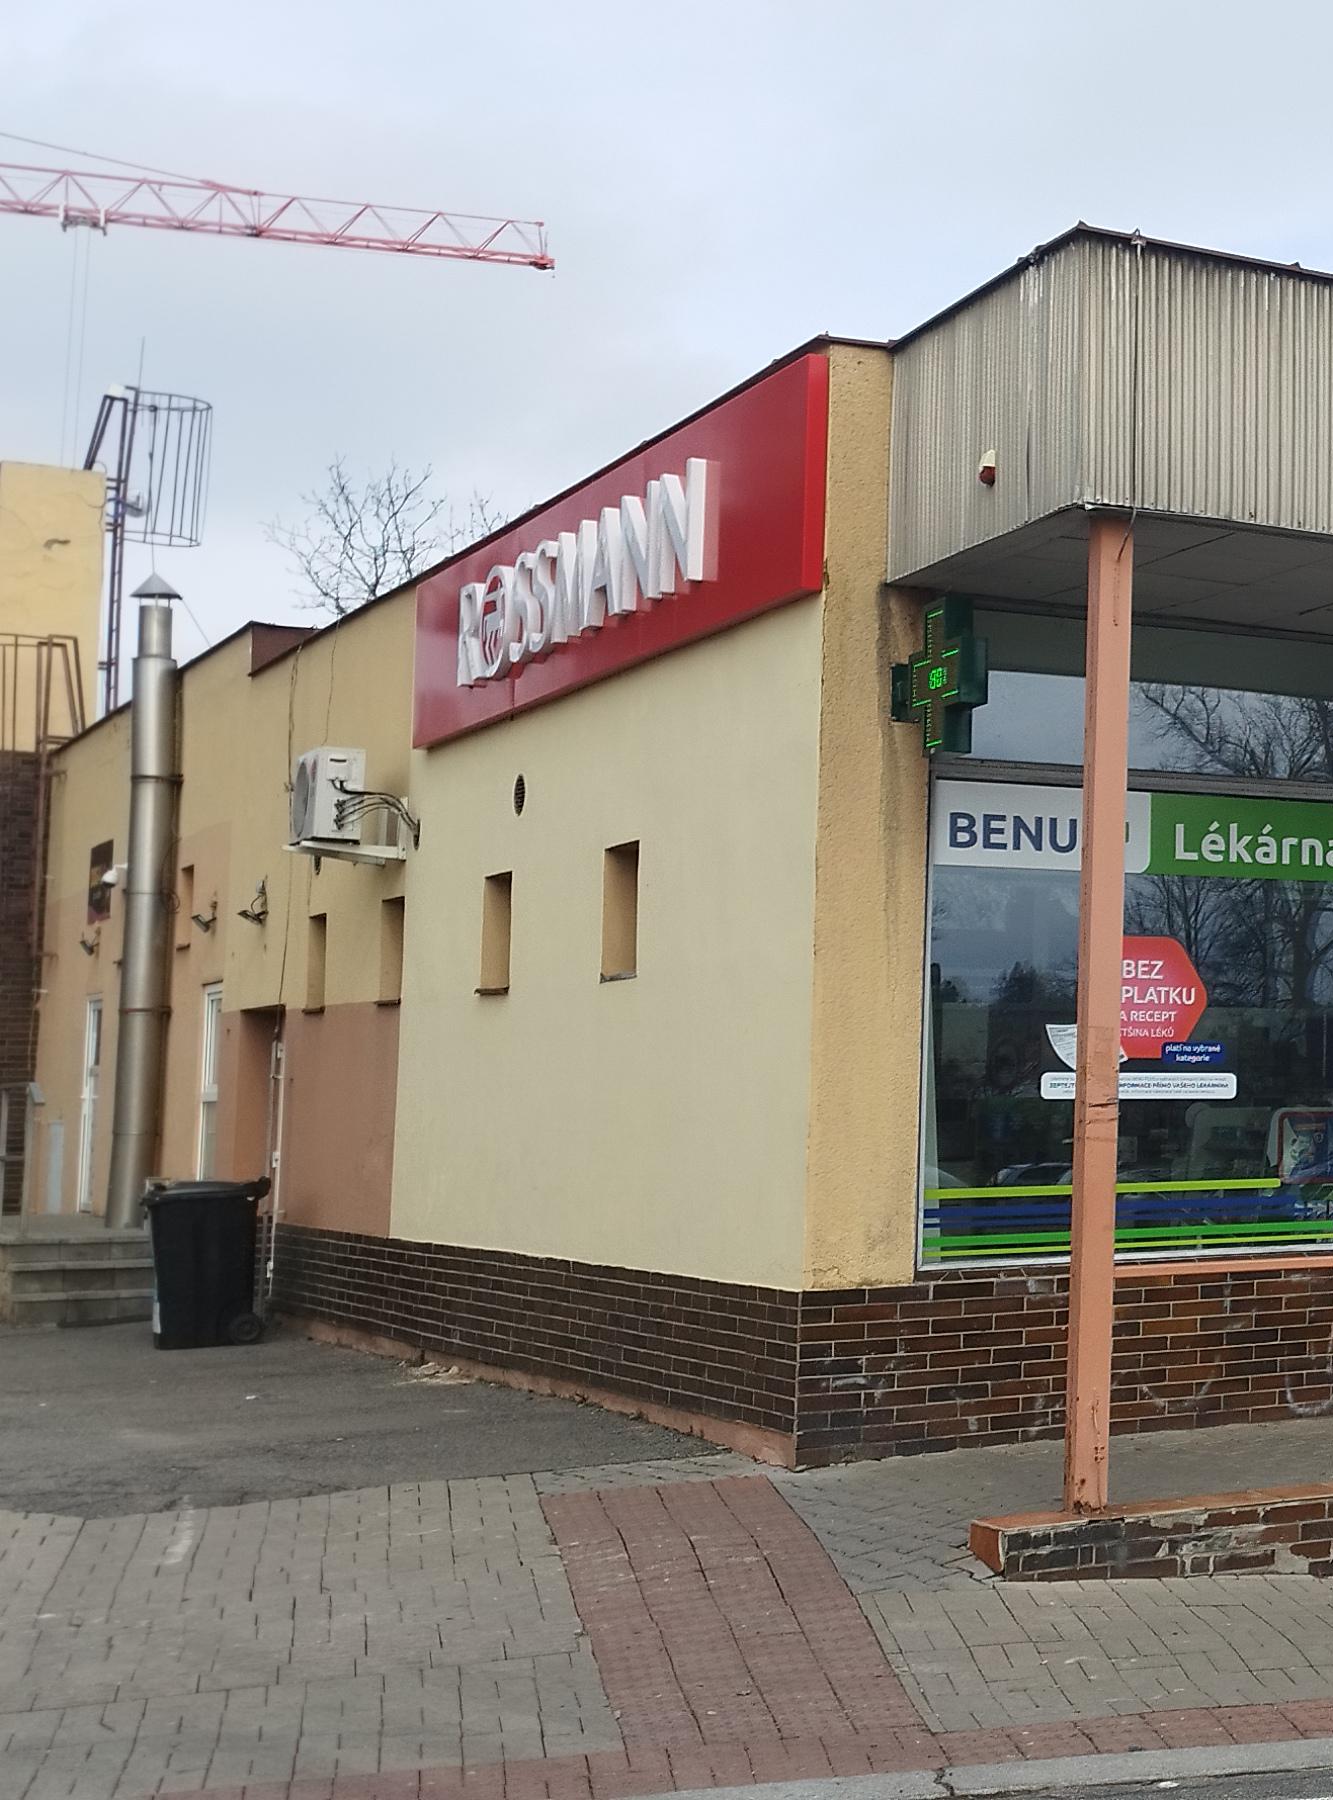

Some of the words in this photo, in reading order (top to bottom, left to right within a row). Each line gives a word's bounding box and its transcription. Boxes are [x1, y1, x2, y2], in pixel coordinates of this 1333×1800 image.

[457, 457, 707, 687] ROSSMANN
[948, 811, 1077, 853] BENU
[1122, 960, 1164, 979] BEZ
[1121, 987, 1196, 1005] PLATKU
[1130, 1011, 1177, 1022] RECEPT
